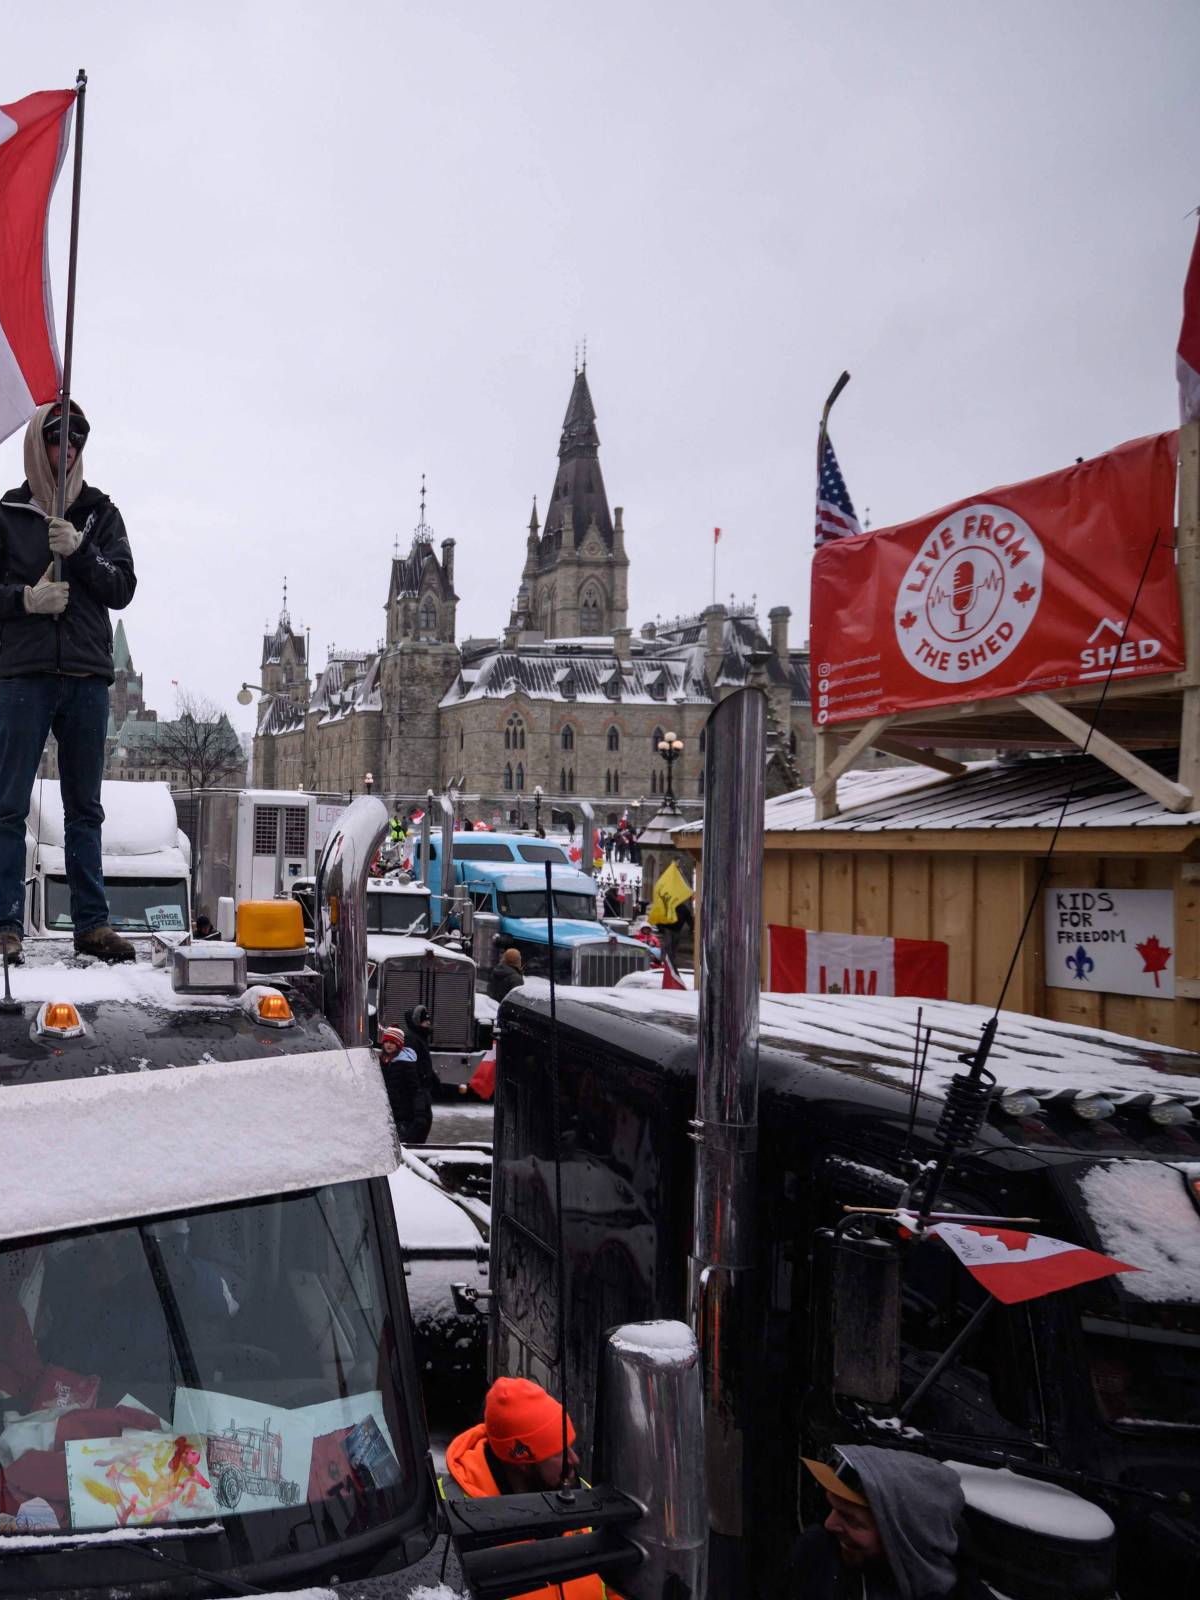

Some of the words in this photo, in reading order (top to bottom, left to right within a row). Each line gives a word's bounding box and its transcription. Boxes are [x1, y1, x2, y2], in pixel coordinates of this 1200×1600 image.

[906, 526, 955, 593] LIVE
[962, 514, 1031, 569] FROM
[914, 638, 952, 671] THE
[957, 621, 1014, 671] SHED
[1079, 639, 1162, 669] SHED
[1056, 892, 1115, 912] KIDS
[150, 912, 179, 921] FRINGE
[152, 919, 182, 927] CITIZEN
[1059, 911, 1093, 928] FOR
[1056, 929, 1127, 944] FREEDOM
